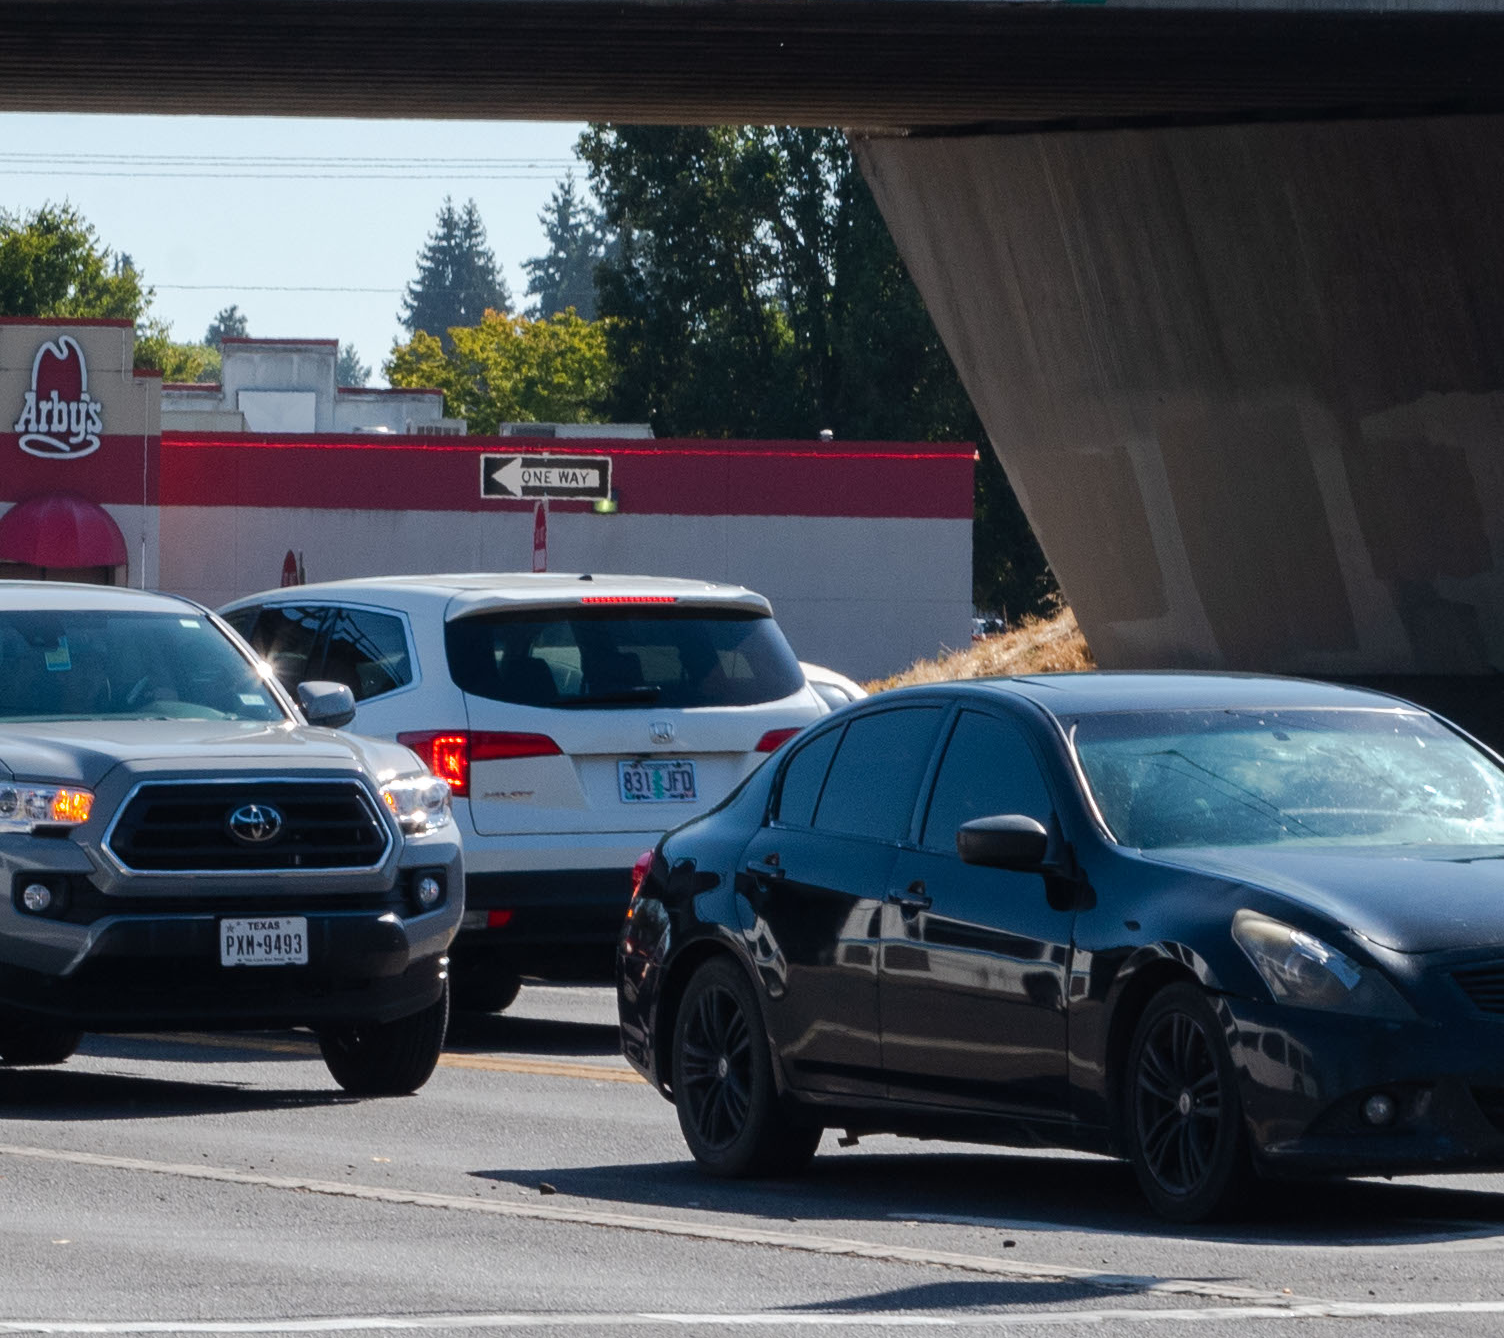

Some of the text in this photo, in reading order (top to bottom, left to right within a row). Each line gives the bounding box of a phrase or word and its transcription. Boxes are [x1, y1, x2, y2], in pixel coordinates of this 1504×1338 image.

[14, 390, 102, 444] Arby's
[521, 470, 590, 485] ONE WAY
[624, 771, 651, 792] 831
[247, 921, 281, 931] TEXAS
